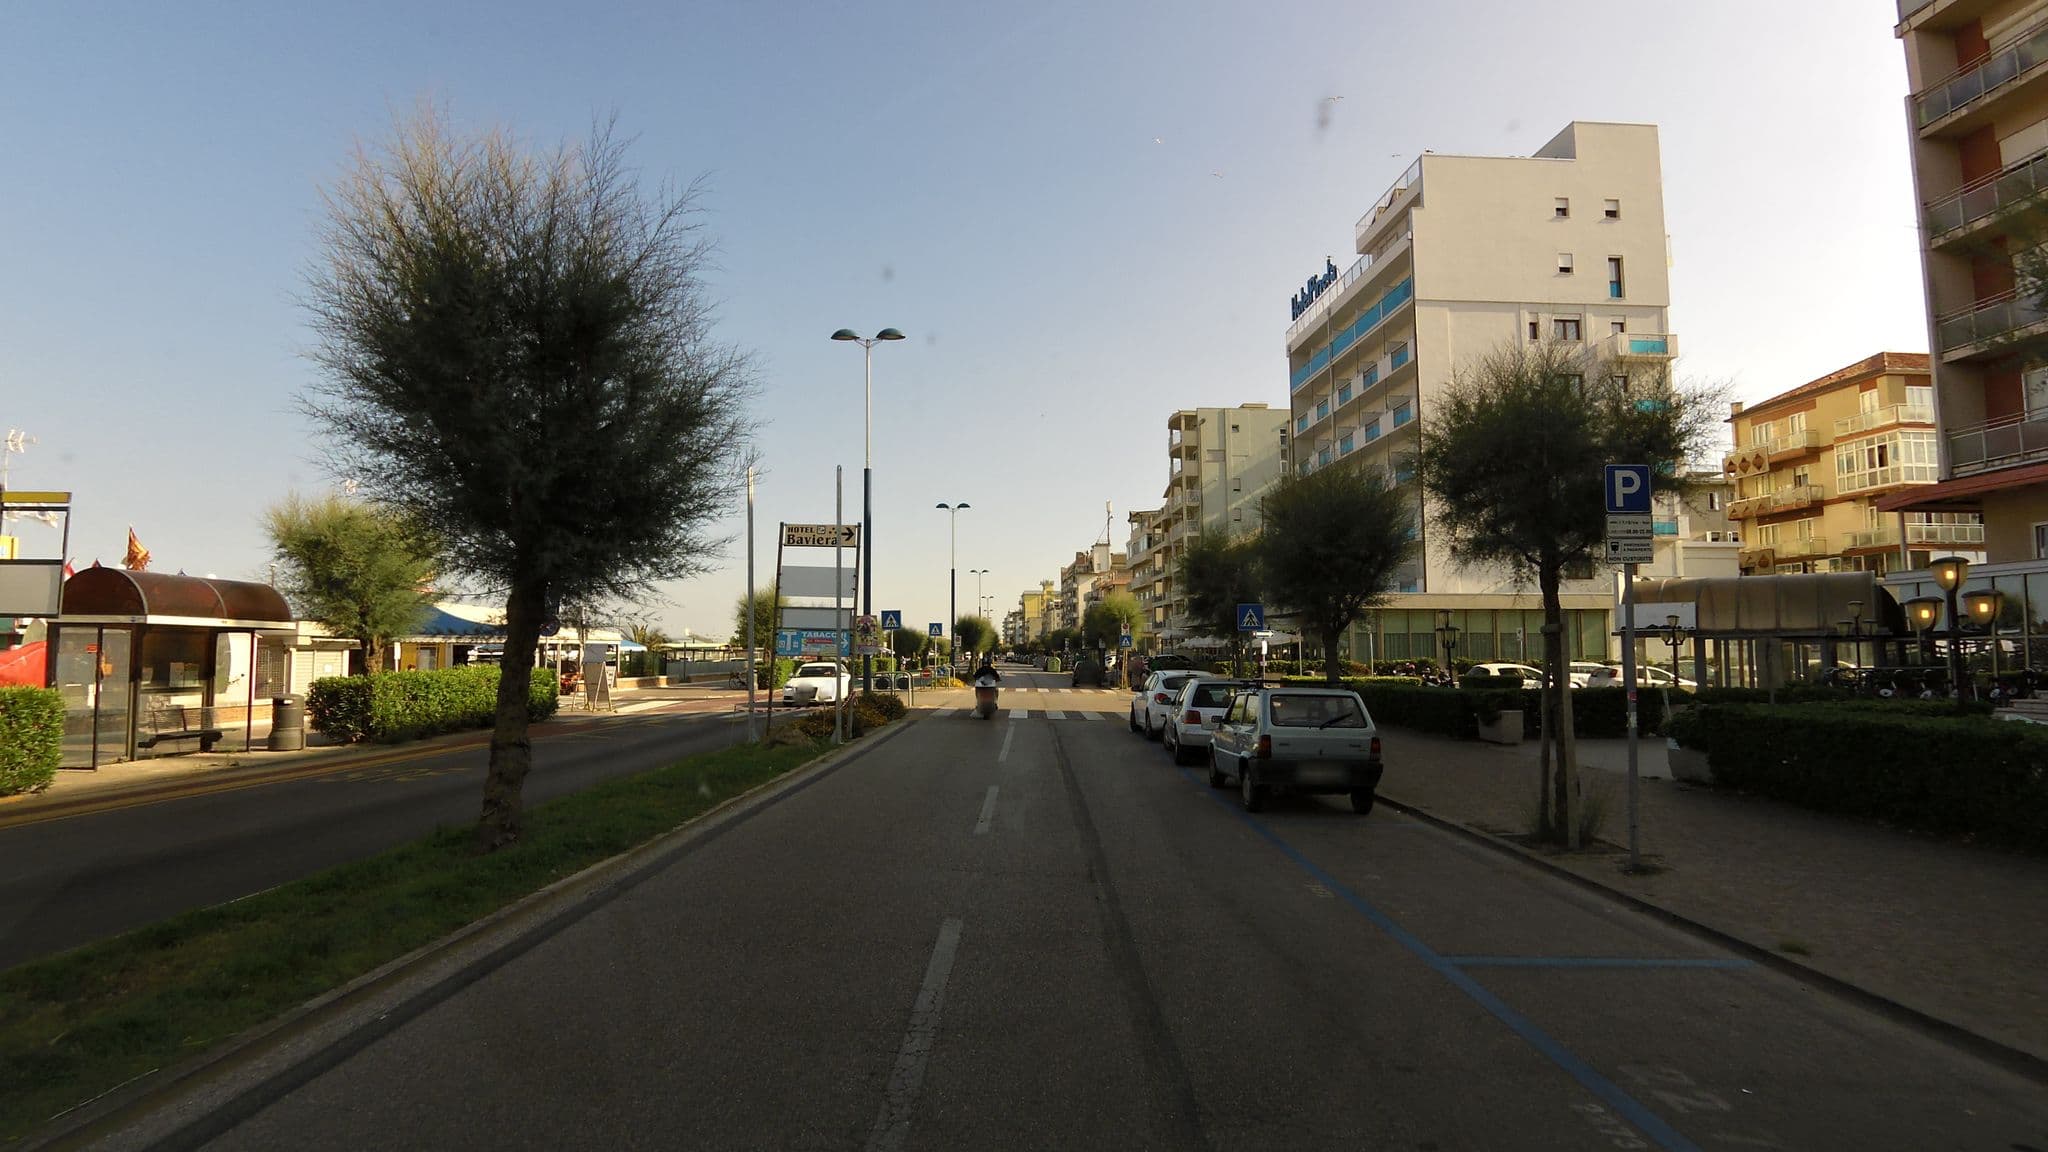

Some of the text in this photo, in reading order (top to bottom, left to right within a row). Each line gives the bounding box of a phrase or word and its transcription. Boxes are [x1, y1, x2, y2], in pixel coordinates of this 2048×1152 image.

[1614, 469, 1641, 508] P
[787, 526, 815, 534] HOTEL
[786, 533, 838, 545] Baviera
